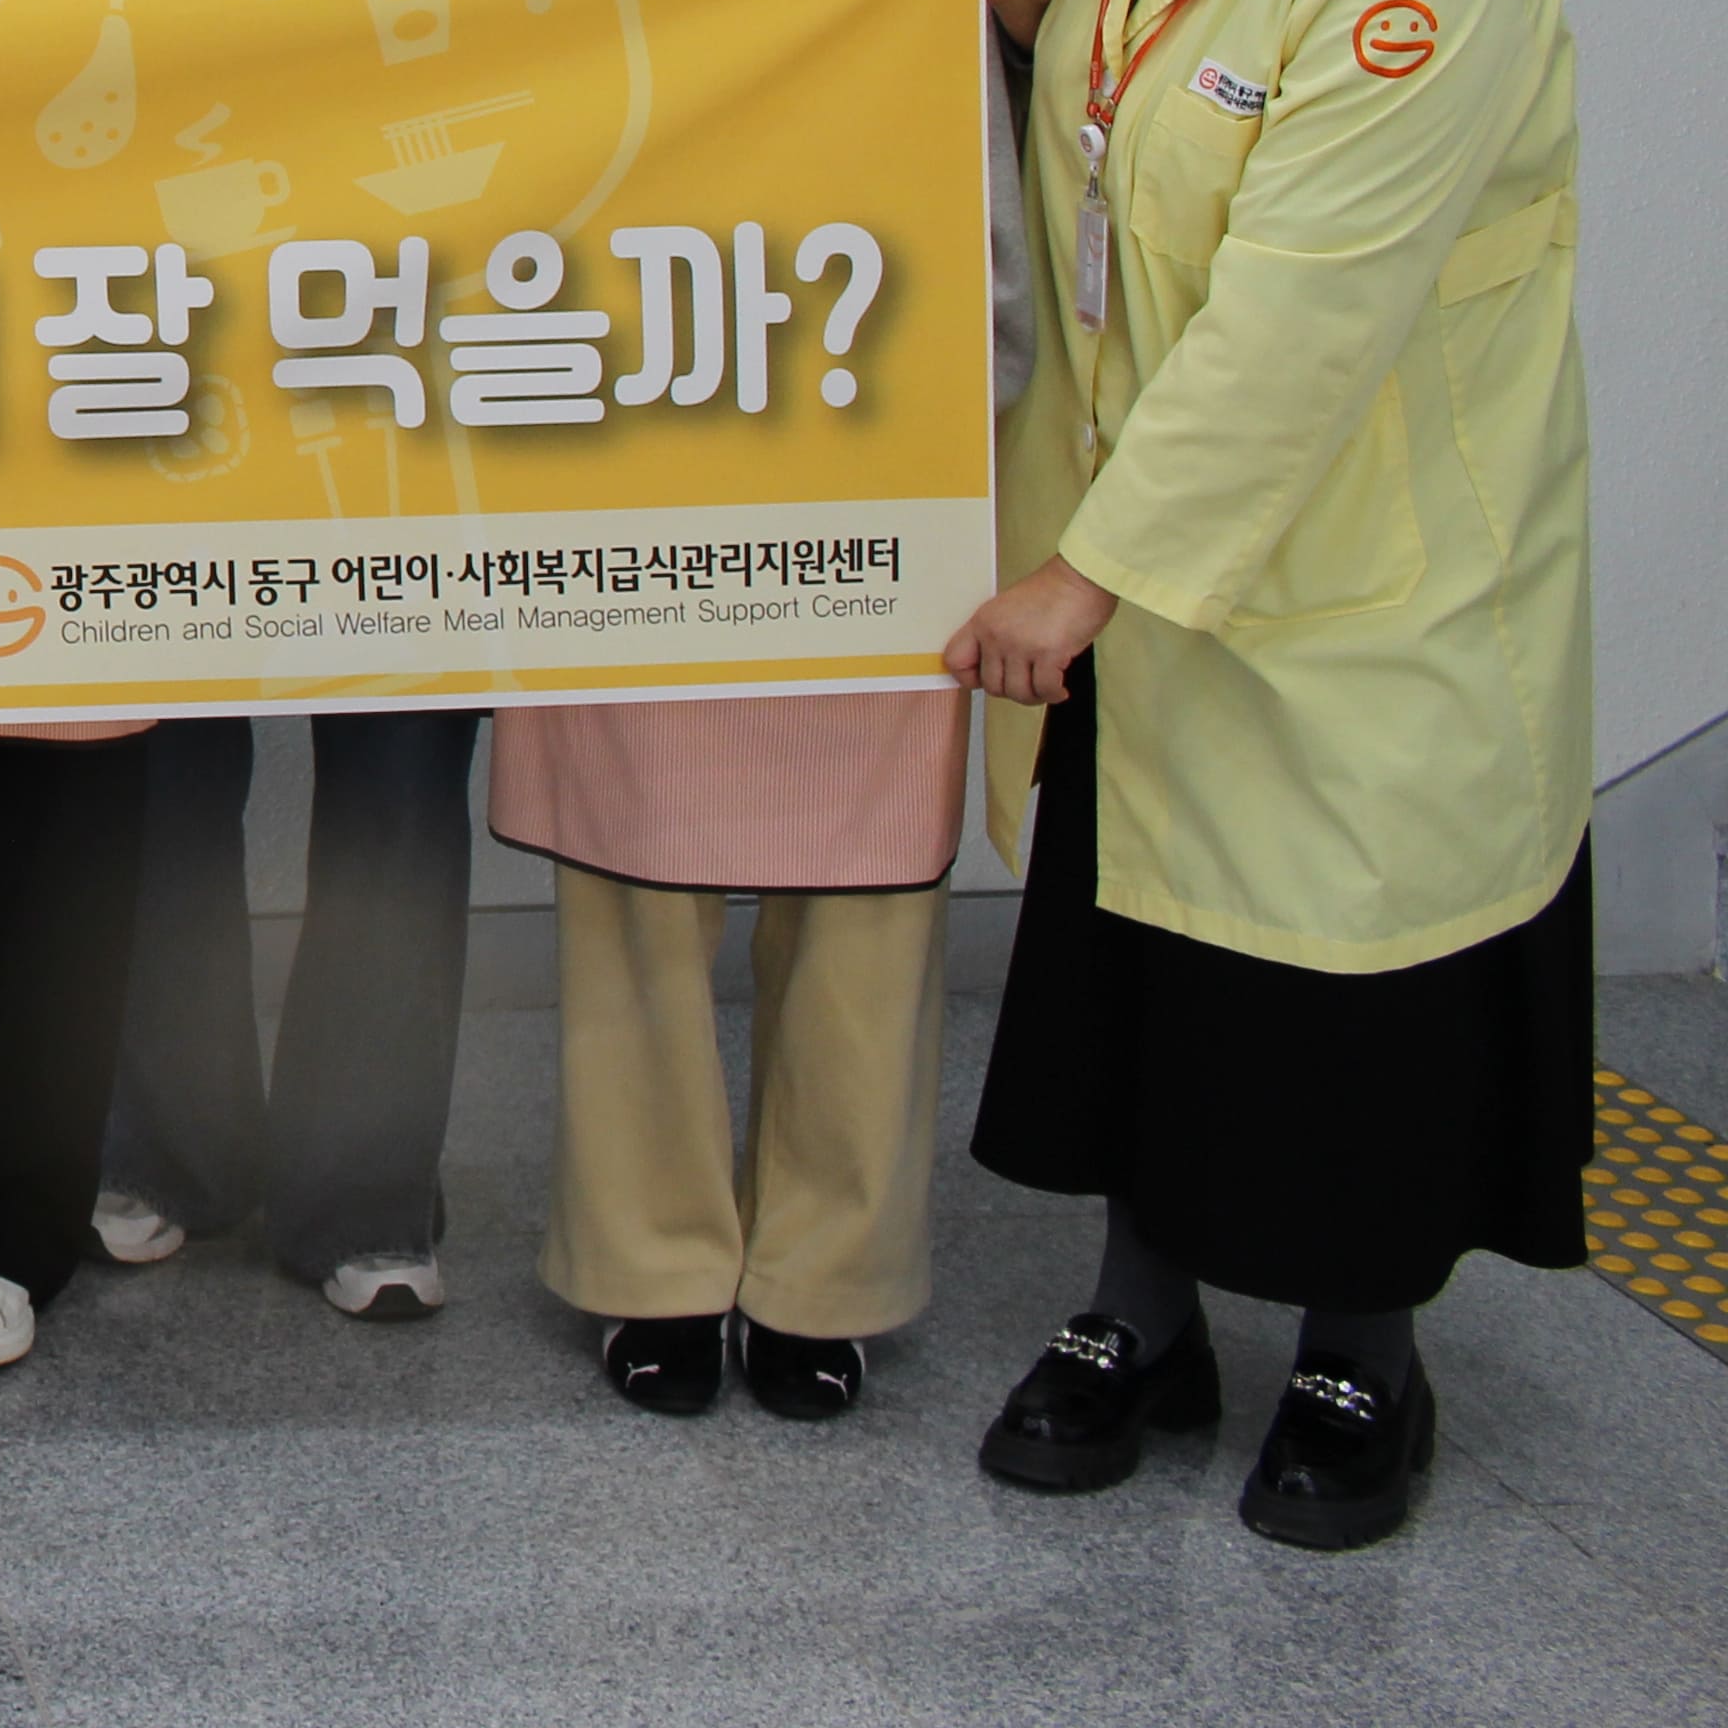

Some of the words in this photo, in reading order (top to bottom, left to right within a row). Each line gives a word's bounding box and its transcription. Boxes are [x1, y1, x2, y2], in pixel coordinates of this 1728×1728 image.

[32, 241, 216, 442] 잘
[266, 218, 887, 432] 먹을까?
[50, 559, 237, 612] 광주광역시
[248, 556, 321, 606] 동구
[60, 618, 171, 645] Children
[182, 616, 232, 641] and
[244, 613, 324, 640] Social
[335, 611, 432, 636] Welfare
[443, 606, 505, 633] Meal
[517, 601, 686, 633] Management
[698, 595, 800, 627] Support
[811, 592, 899, 618] Center
